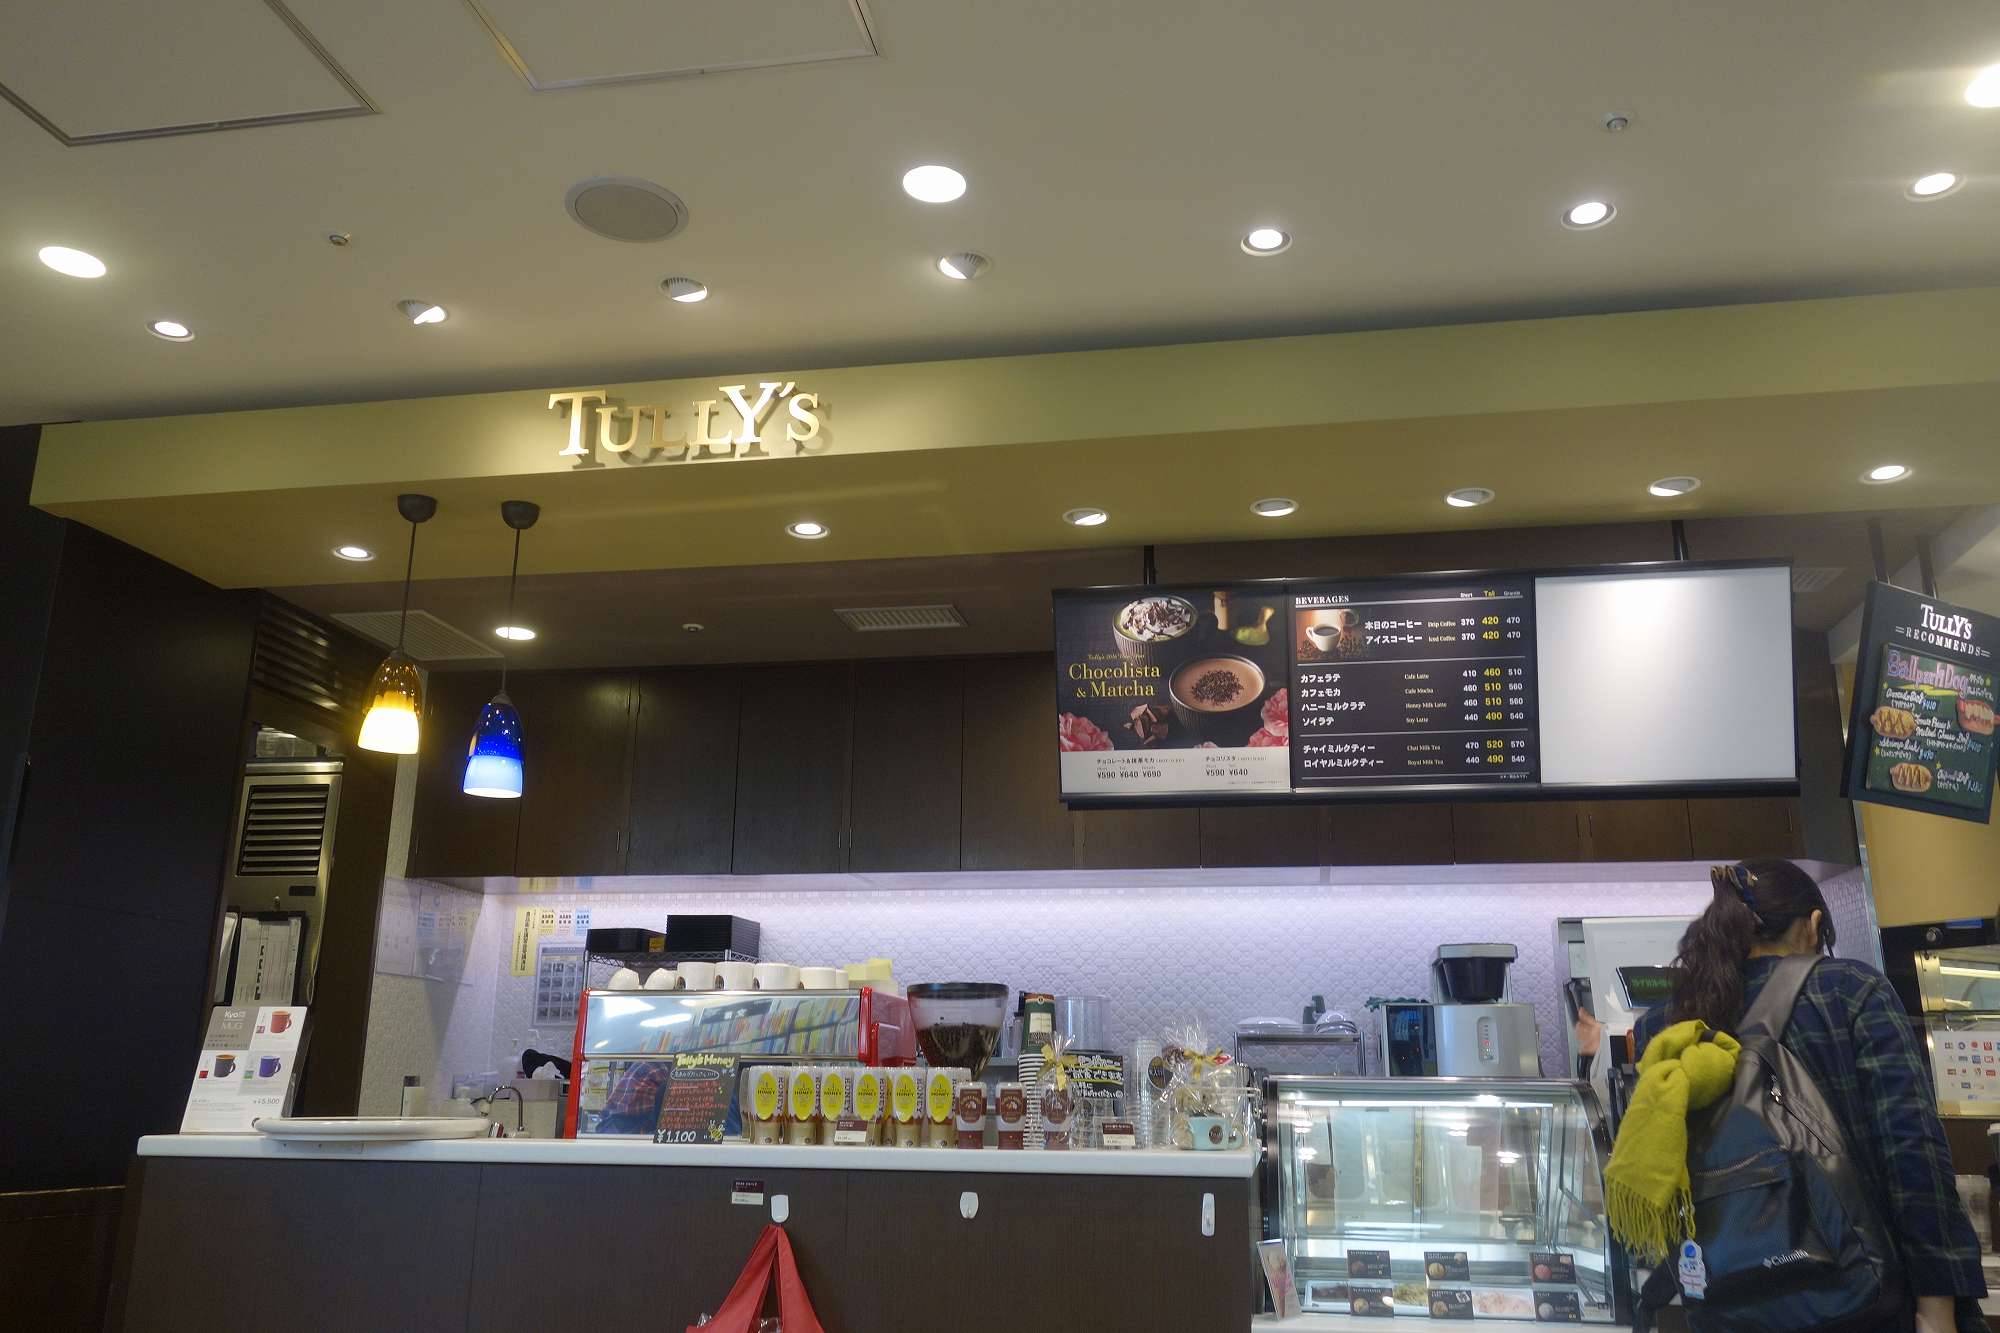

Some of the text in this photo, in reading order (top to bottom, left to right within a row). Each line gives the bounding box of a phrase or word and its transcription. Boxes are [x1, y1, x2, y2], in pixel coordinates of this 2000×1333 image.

[548, 381, 820, 456] TULLY'S
[1296, 596, 1349, 604] BEVERAGES
[1365, 619, 1422, 630] 本日のコーヒー
[1482, 616, 1498, 624] 420
[1920, 604, 1972, 640] TULLY'S
[1366, 634, 1422, 645] アイスコーヒー
[1482, 631, 1499, 639] 420
[1906, 627, 1980, 656] RECOMMENDS
[1069, 663, 1160, 680] Chocolista
[1301, 674, 1341, 683] カフェラテ
[1076, 680, 1155, 698] & Matcha
[1484, 682, 1501, 691] 510
[1301, 688, 1341, 697] カフェモカ
[1302, 702, 1366, 711] ハニーミルクラテ
[1486, 712, 1502, 720] 490
[1302, 717, 1334, 726] ソイラテ
[1303, 743, 1375, 754] チャイミルクティー
[1487, 740, 1503, 748] 520
[1304, 758, 1384, 768] ロイヤルミルクティー
[1487, 755, 1504, 763] 490
[676, 1053, 735, 1068] Tully's Honey
